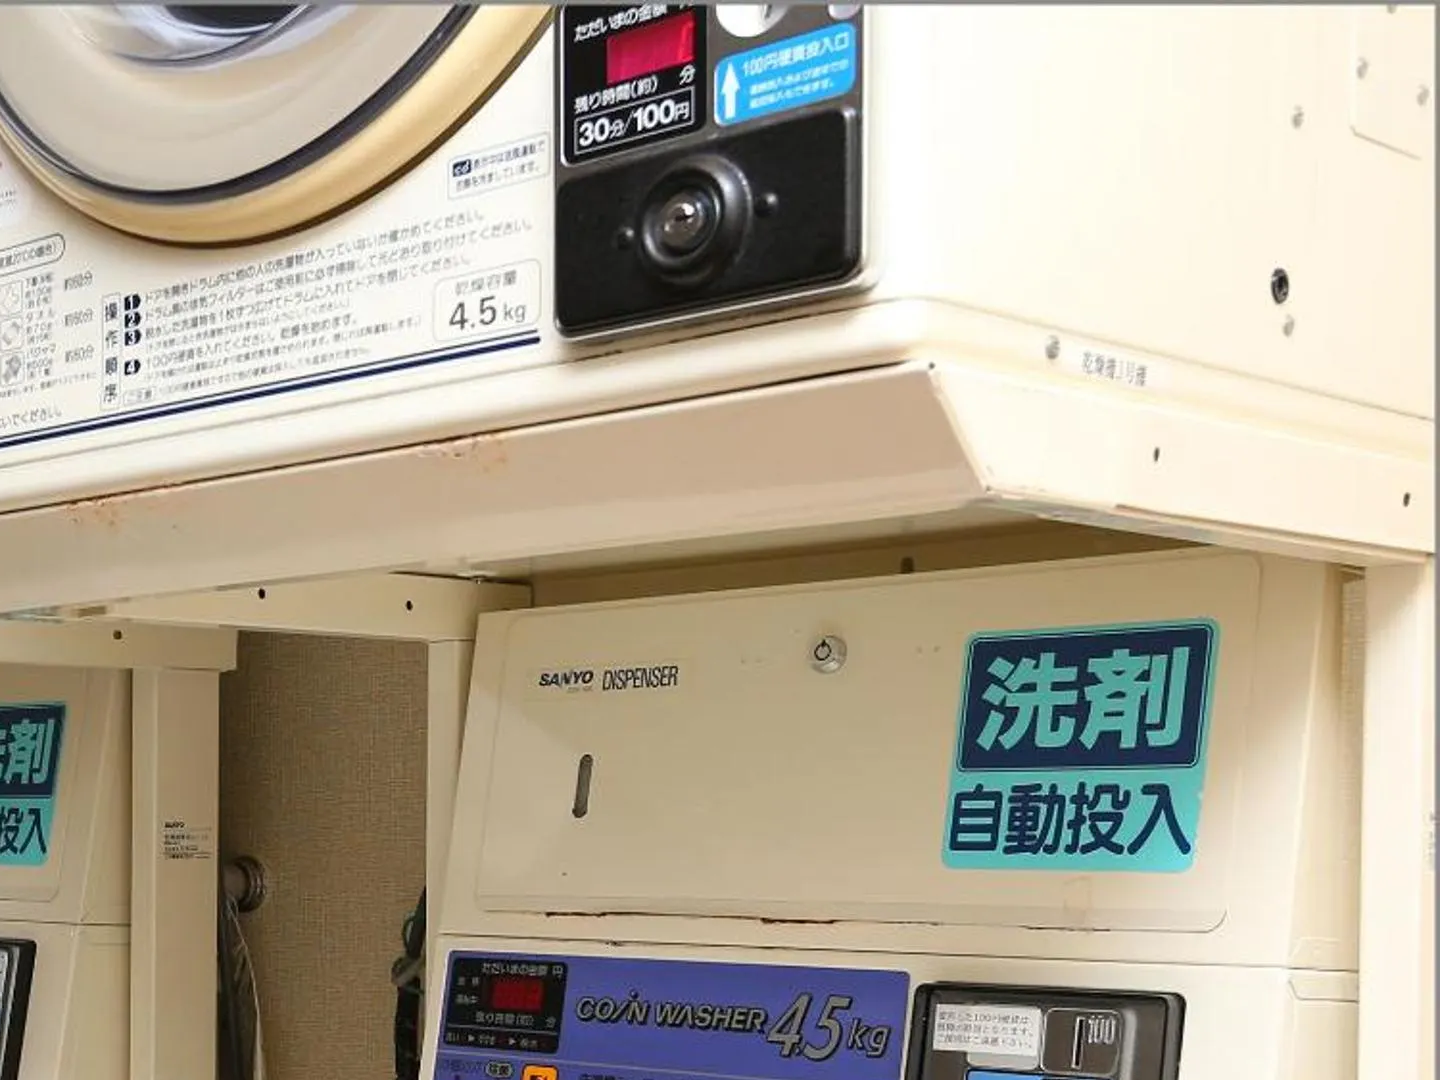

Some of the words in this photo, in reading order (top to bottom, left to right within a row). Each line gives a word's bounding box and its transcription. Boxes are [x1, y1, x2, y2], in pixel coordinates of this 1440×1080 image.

[679, 65, 695, 84] 分
[539, 670, 594, 687] SANYO
[602, 666, 678, 690] DISPENSER
[976, 645, 1190, 753] 洗剤
[948, 783, 1193, 857] 自動投入
[576, 989, 648, 1024] COIN
[657, 1003, 766, 1034] WASHER
